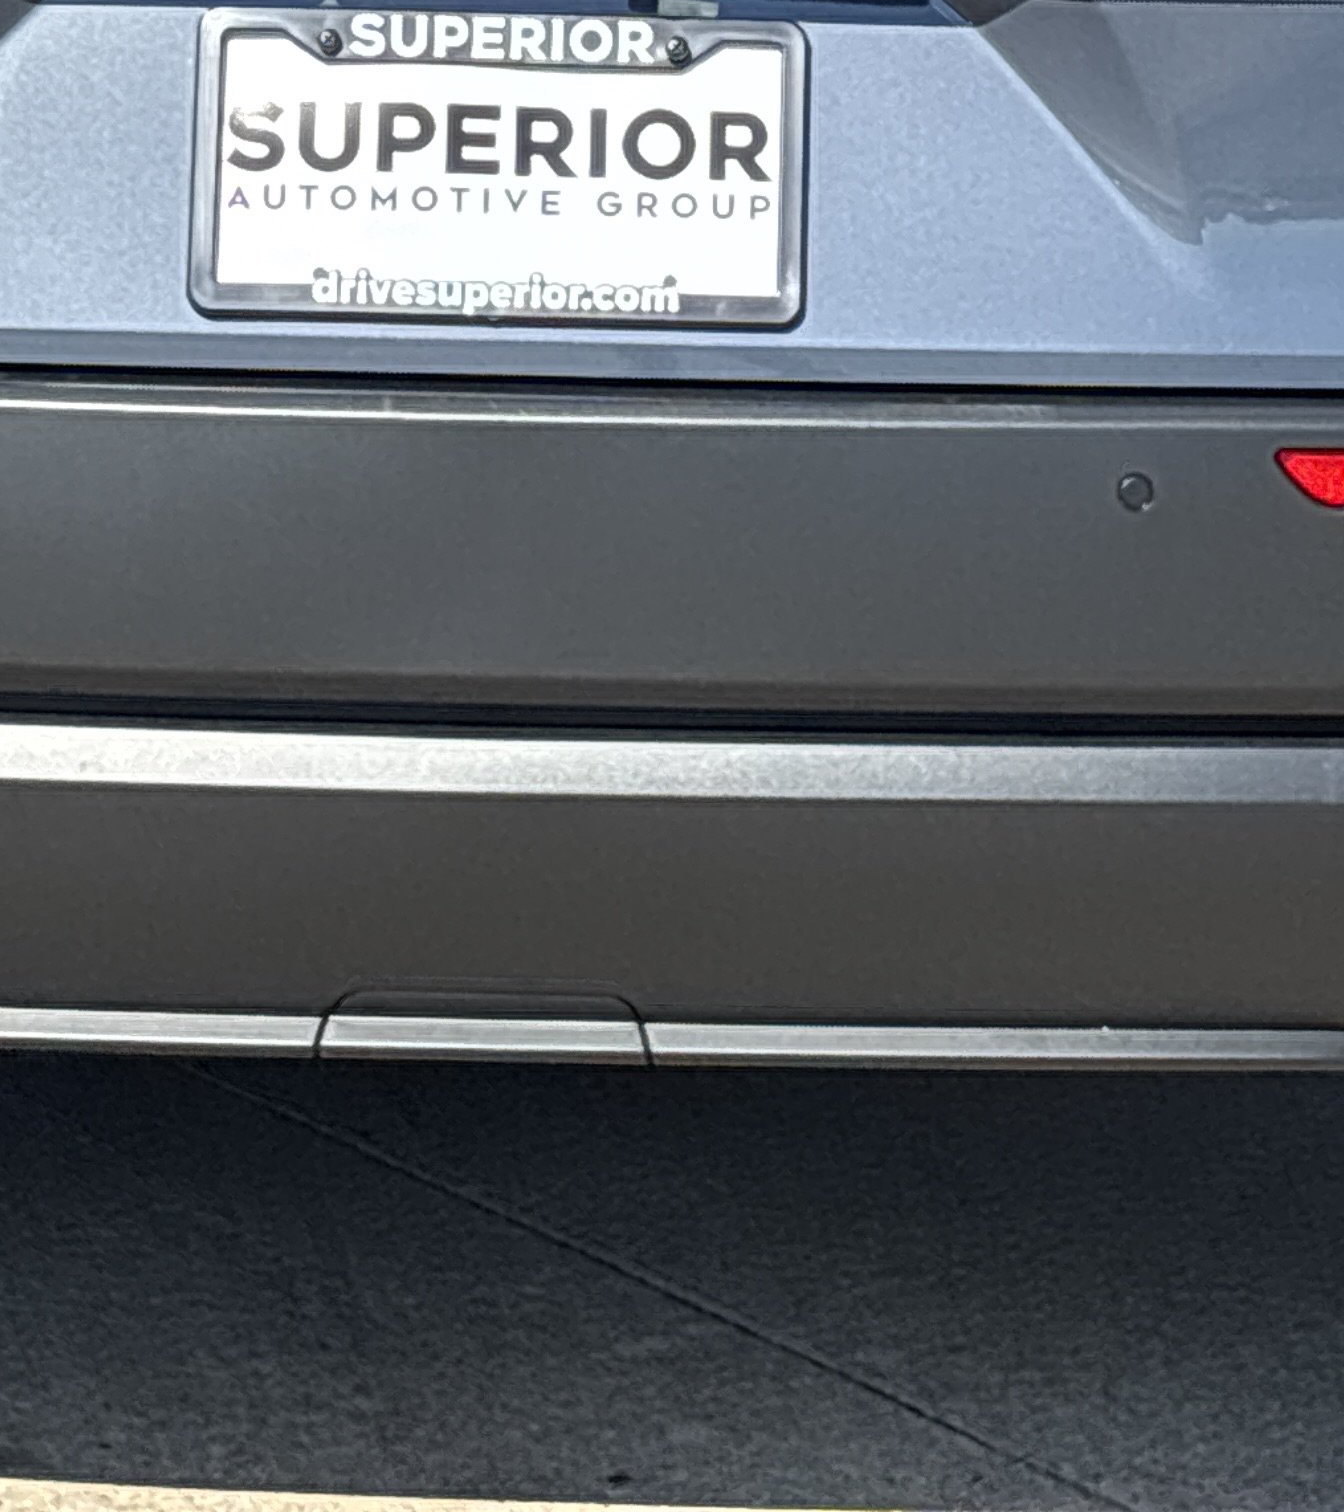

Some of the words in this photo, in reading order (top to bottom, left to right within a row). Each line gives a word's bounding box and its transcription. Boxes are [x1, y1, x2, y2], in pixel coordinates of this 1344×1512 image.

[348, 12, 655, 64] SUPERIOR
[226, 102, 772, 182] SUPERIOR
[227, 184, 561, 216] AUTOMOTIVE
[597, 191, 771, 220] GROUP
[311, 267, 680, 316] drivesuperior.com
